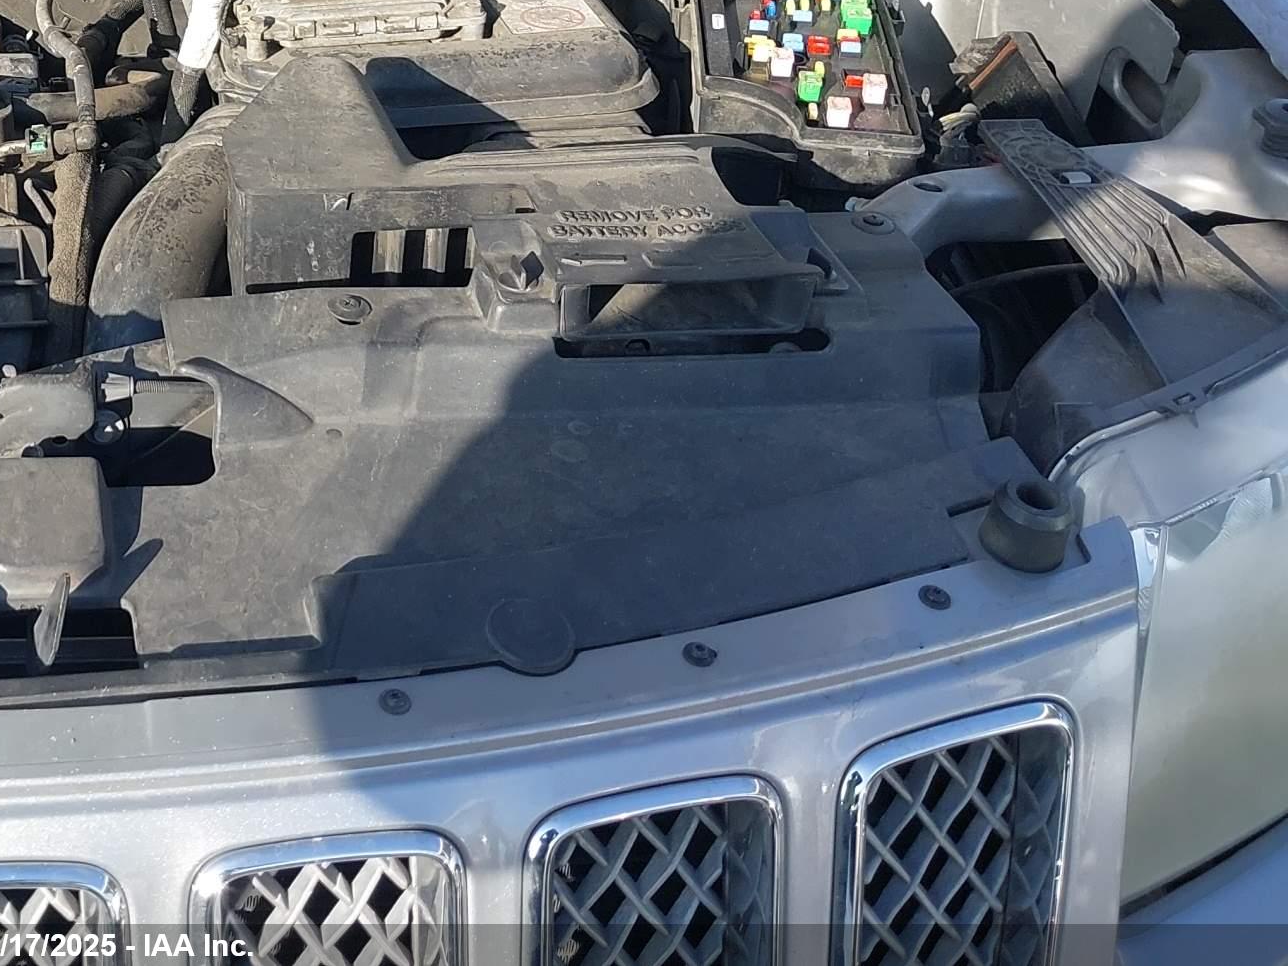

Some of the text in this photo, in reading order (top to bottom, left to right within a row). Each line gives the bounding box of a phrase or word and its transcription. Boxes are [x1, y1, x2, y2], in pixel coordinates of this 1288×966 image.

[557, 205, 711, 223] REMOVE FOR
[547, 218, 747, 238] BATTERY ACCESS
